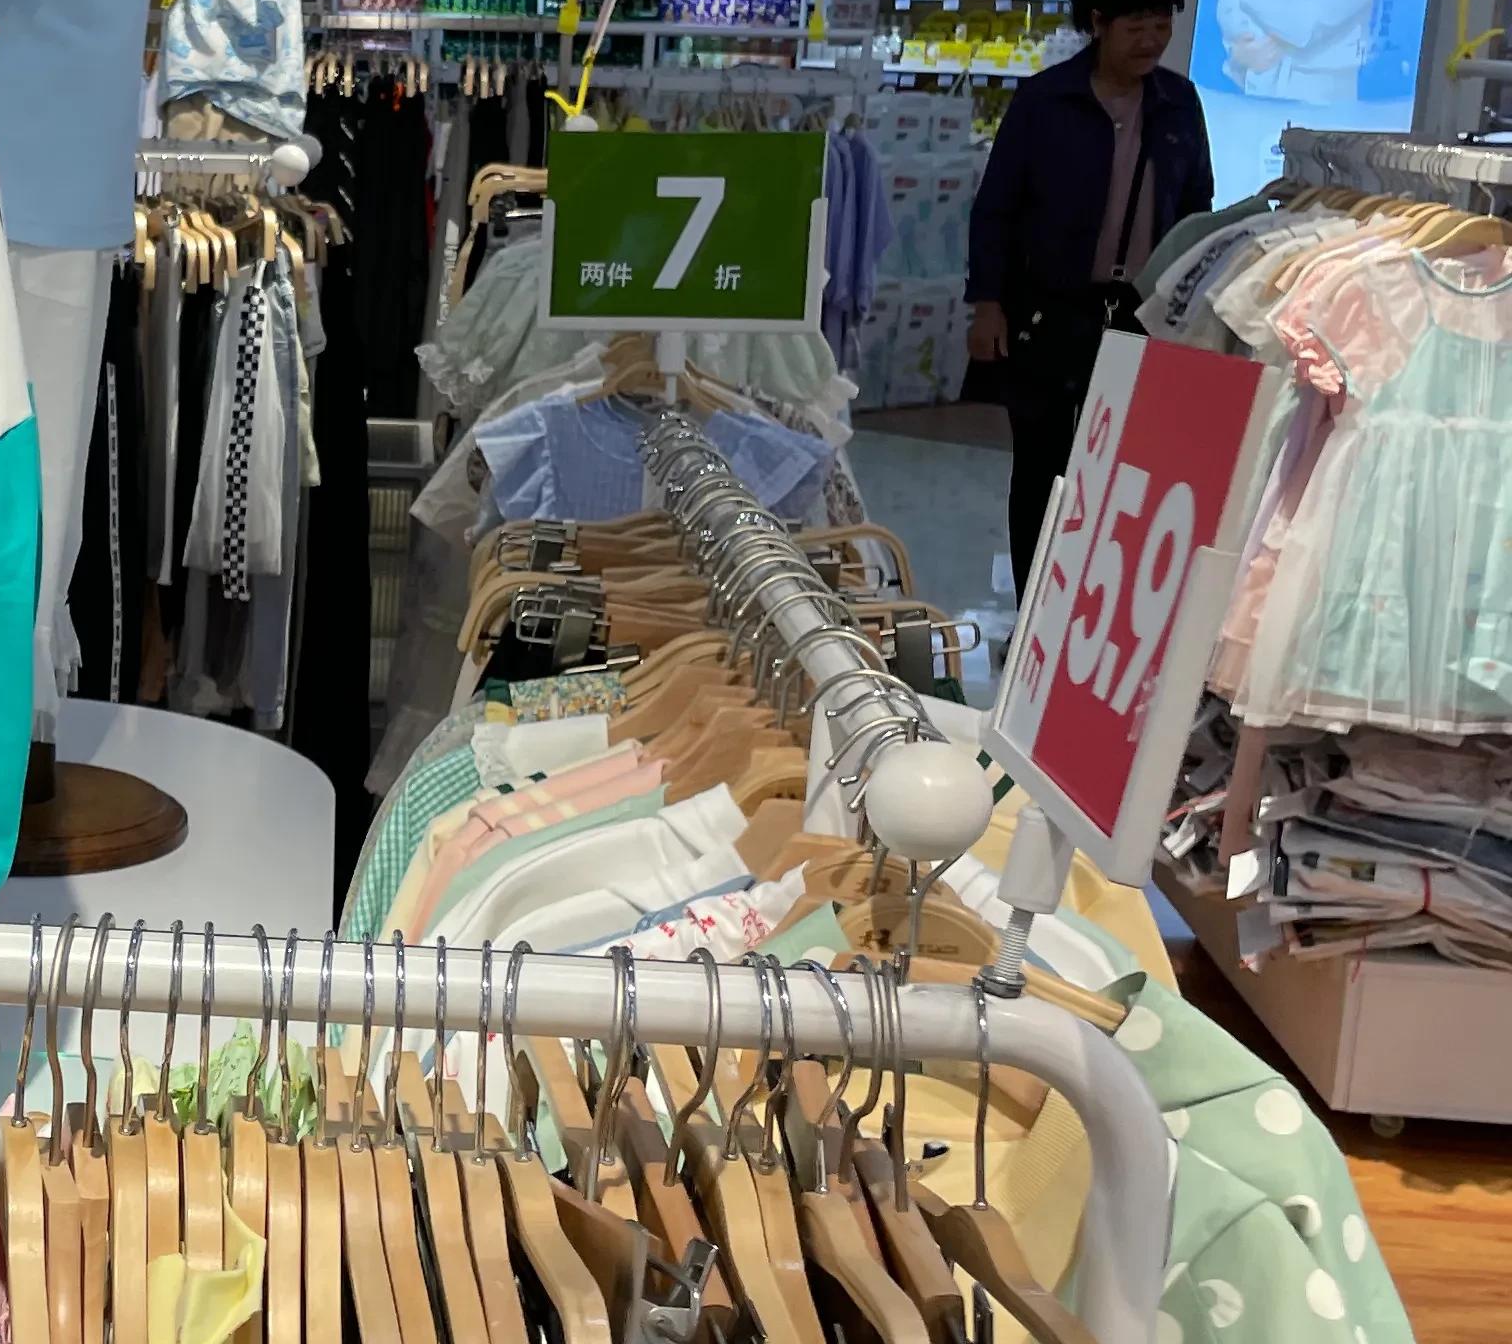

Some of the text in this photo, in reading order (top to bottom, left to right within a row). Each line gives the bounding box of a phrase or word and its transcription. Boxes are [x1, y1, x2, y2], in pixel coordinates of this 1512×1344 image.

[580, 176, 741, 290] 两件 7 折
